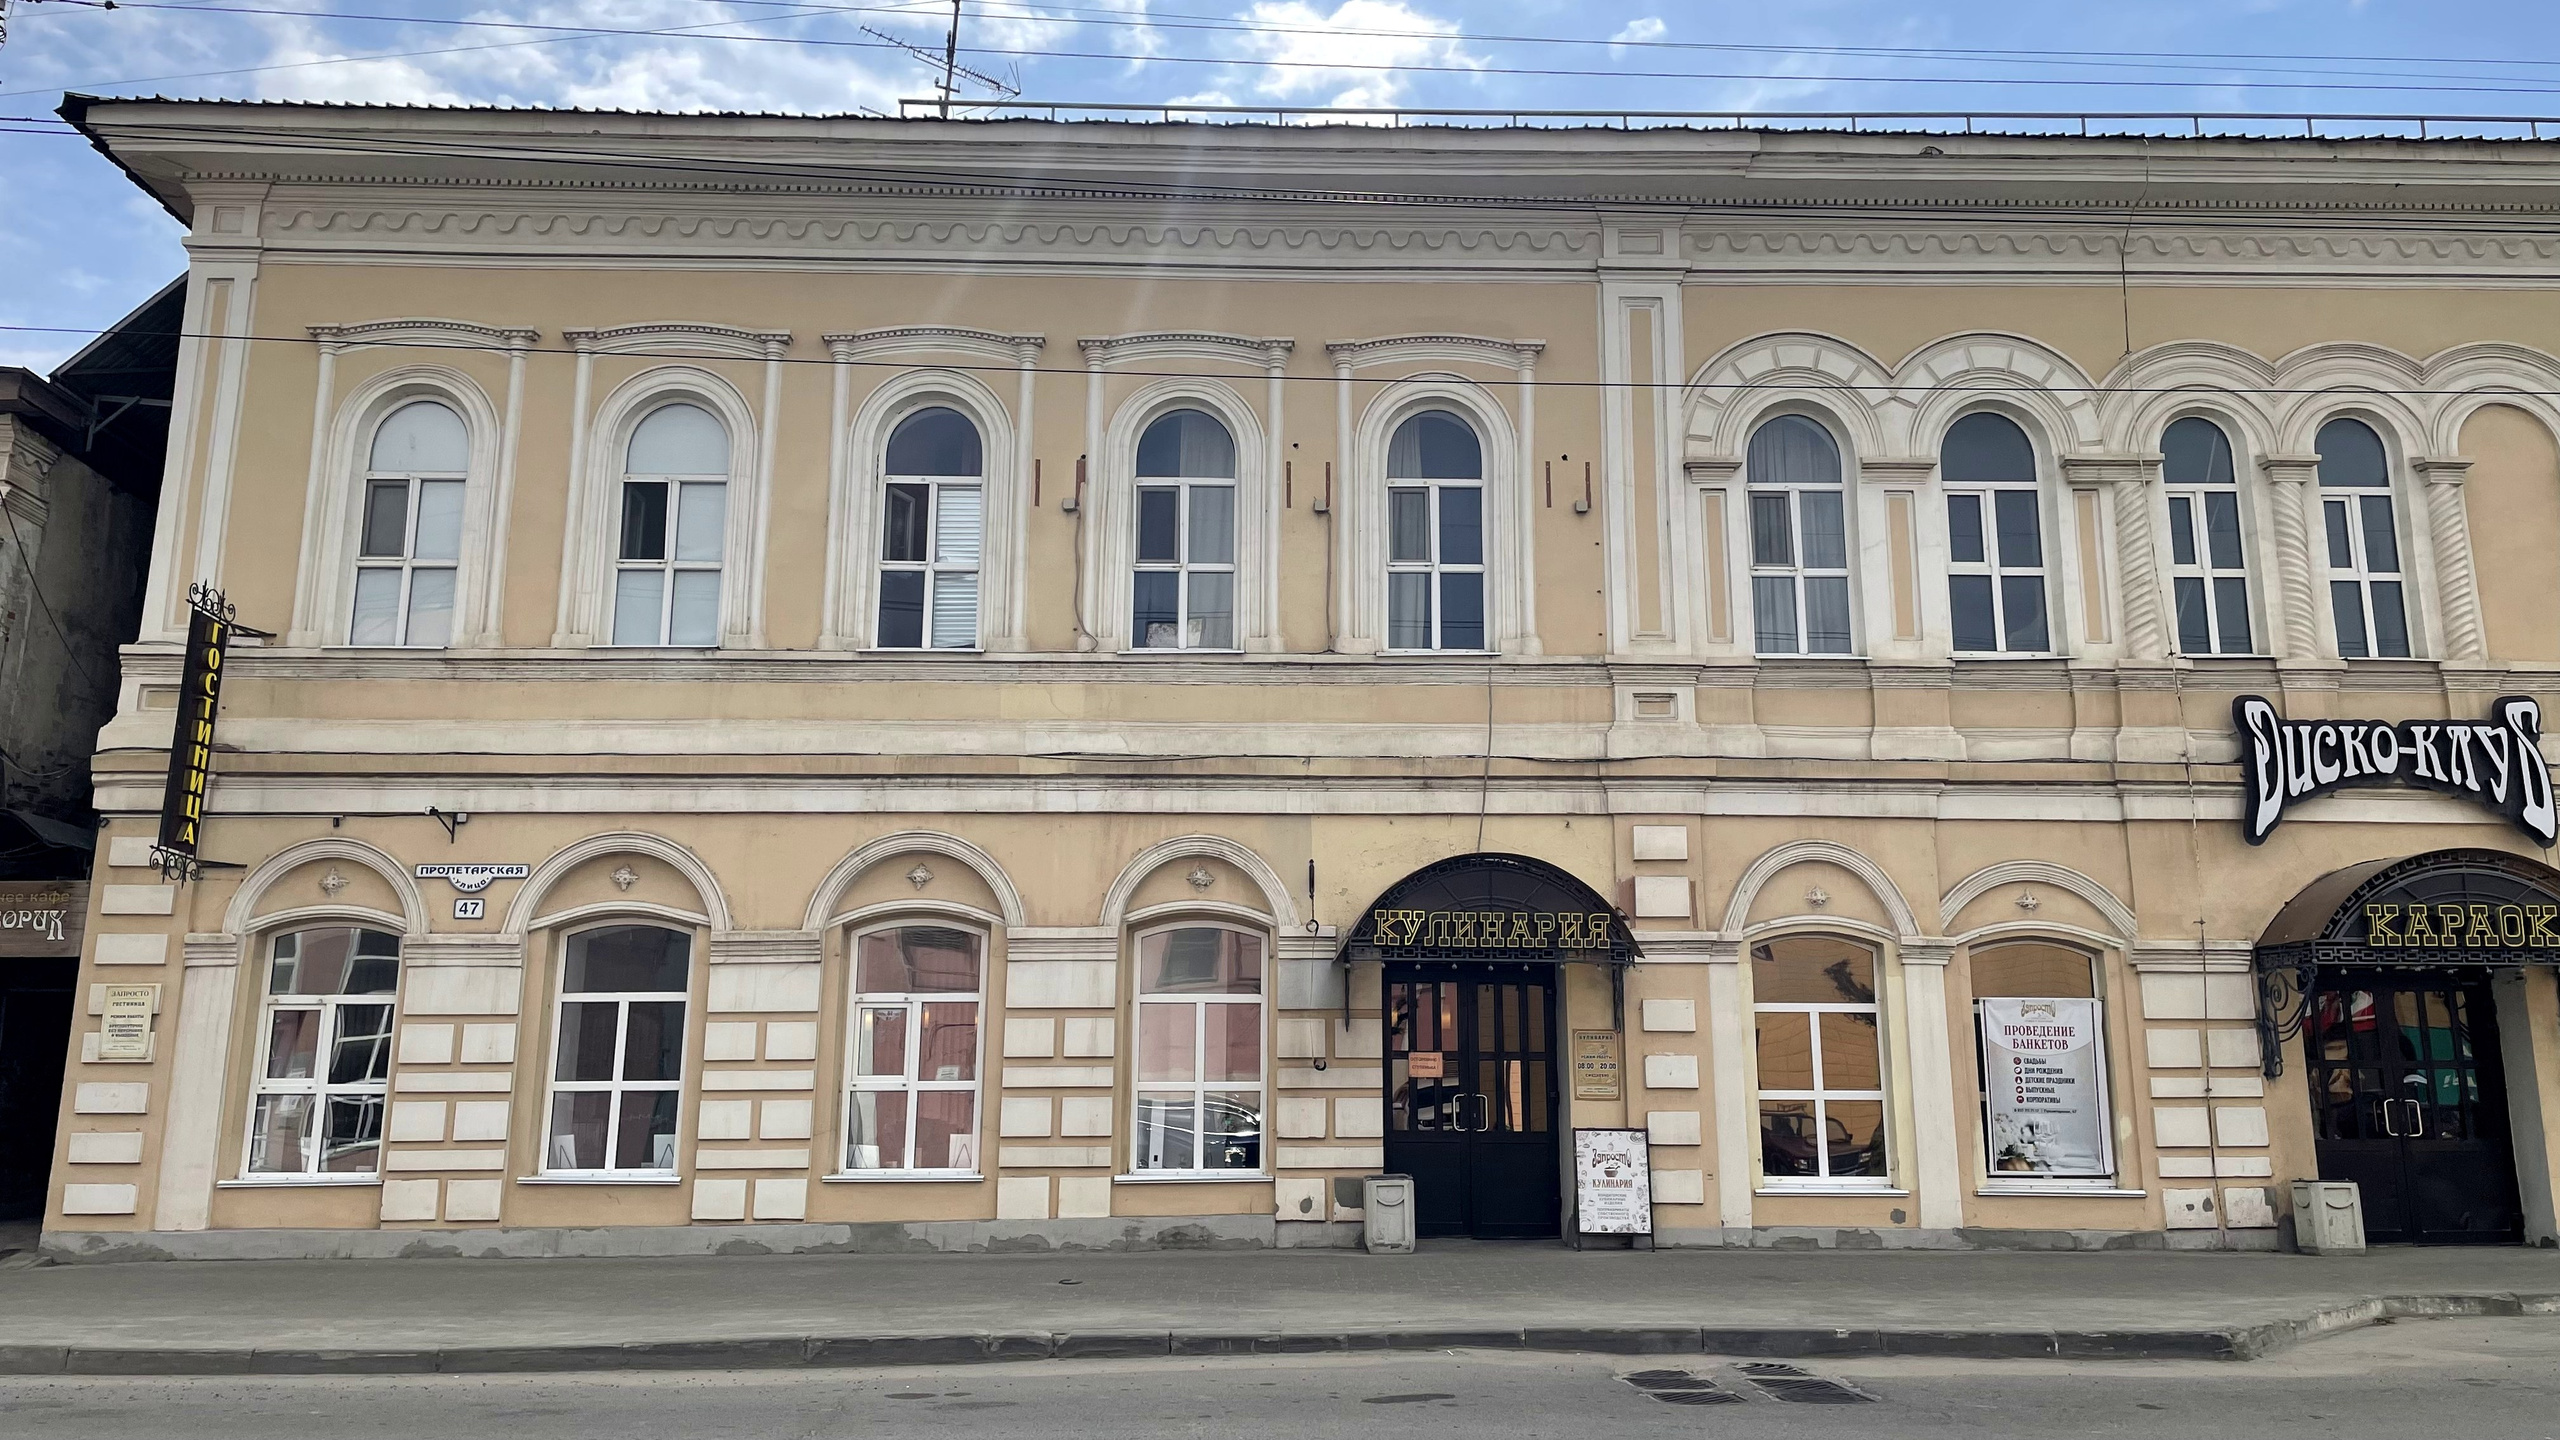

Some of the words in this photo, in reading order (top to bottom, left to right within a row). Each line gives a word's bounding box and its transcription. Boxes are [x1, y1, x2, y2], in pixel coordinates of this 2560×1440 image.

[181, 621, 222, 845] ГОСТИНИЦА
[420, 866, 524, 875] ПРОЛЕТАРСКАЯ
[29, 890, 70, 904] кафе
[459, 902, 480, 915] 47
[0, 910, 67, 940] ОРИК
[1373, 910, 1611, 949] КУЛИНАРИЯ
[2004, 1025, 2076, 1038] ПРОВЕДЕНИЕ
[2012, 1038, 2069, 1050] БАНКЕТОВ
[1592, 1179, 1633, 1189] КУЛИНАРИЯ
